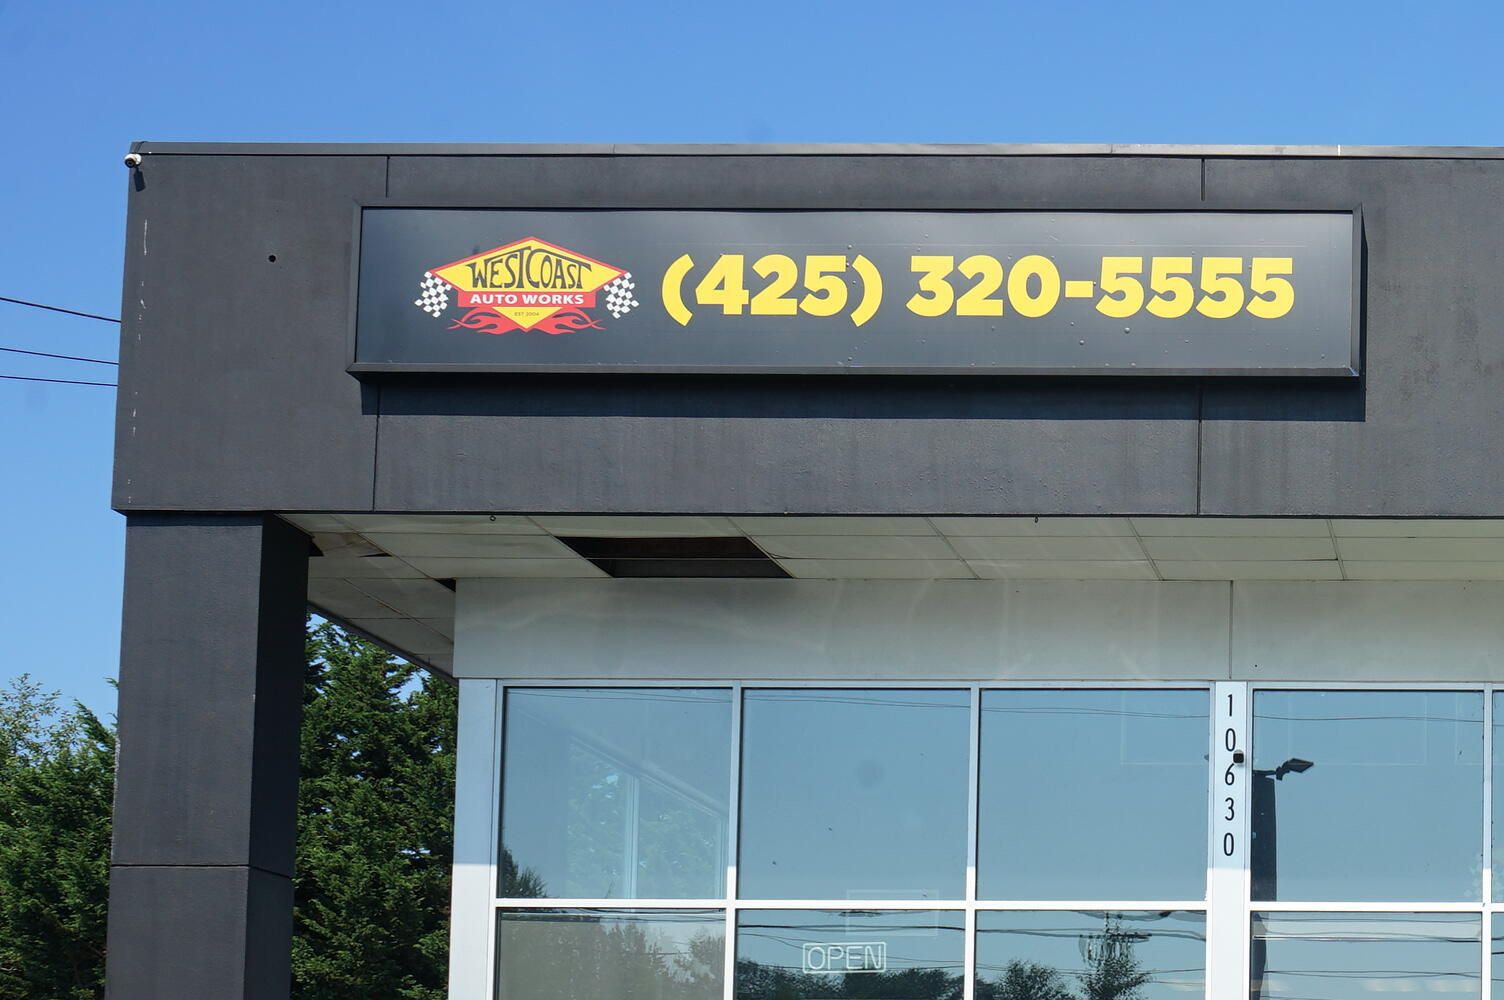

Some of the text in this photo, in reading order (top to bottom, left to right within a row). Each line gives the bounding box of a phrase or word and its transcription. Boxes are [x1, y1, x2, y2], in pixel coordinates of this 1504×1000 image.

[470, 294, 584, 305] AUTO WORKS
[662, 254, 1294, 326] (425) 320-5555
[808, 945, 882, 970] OPEN
